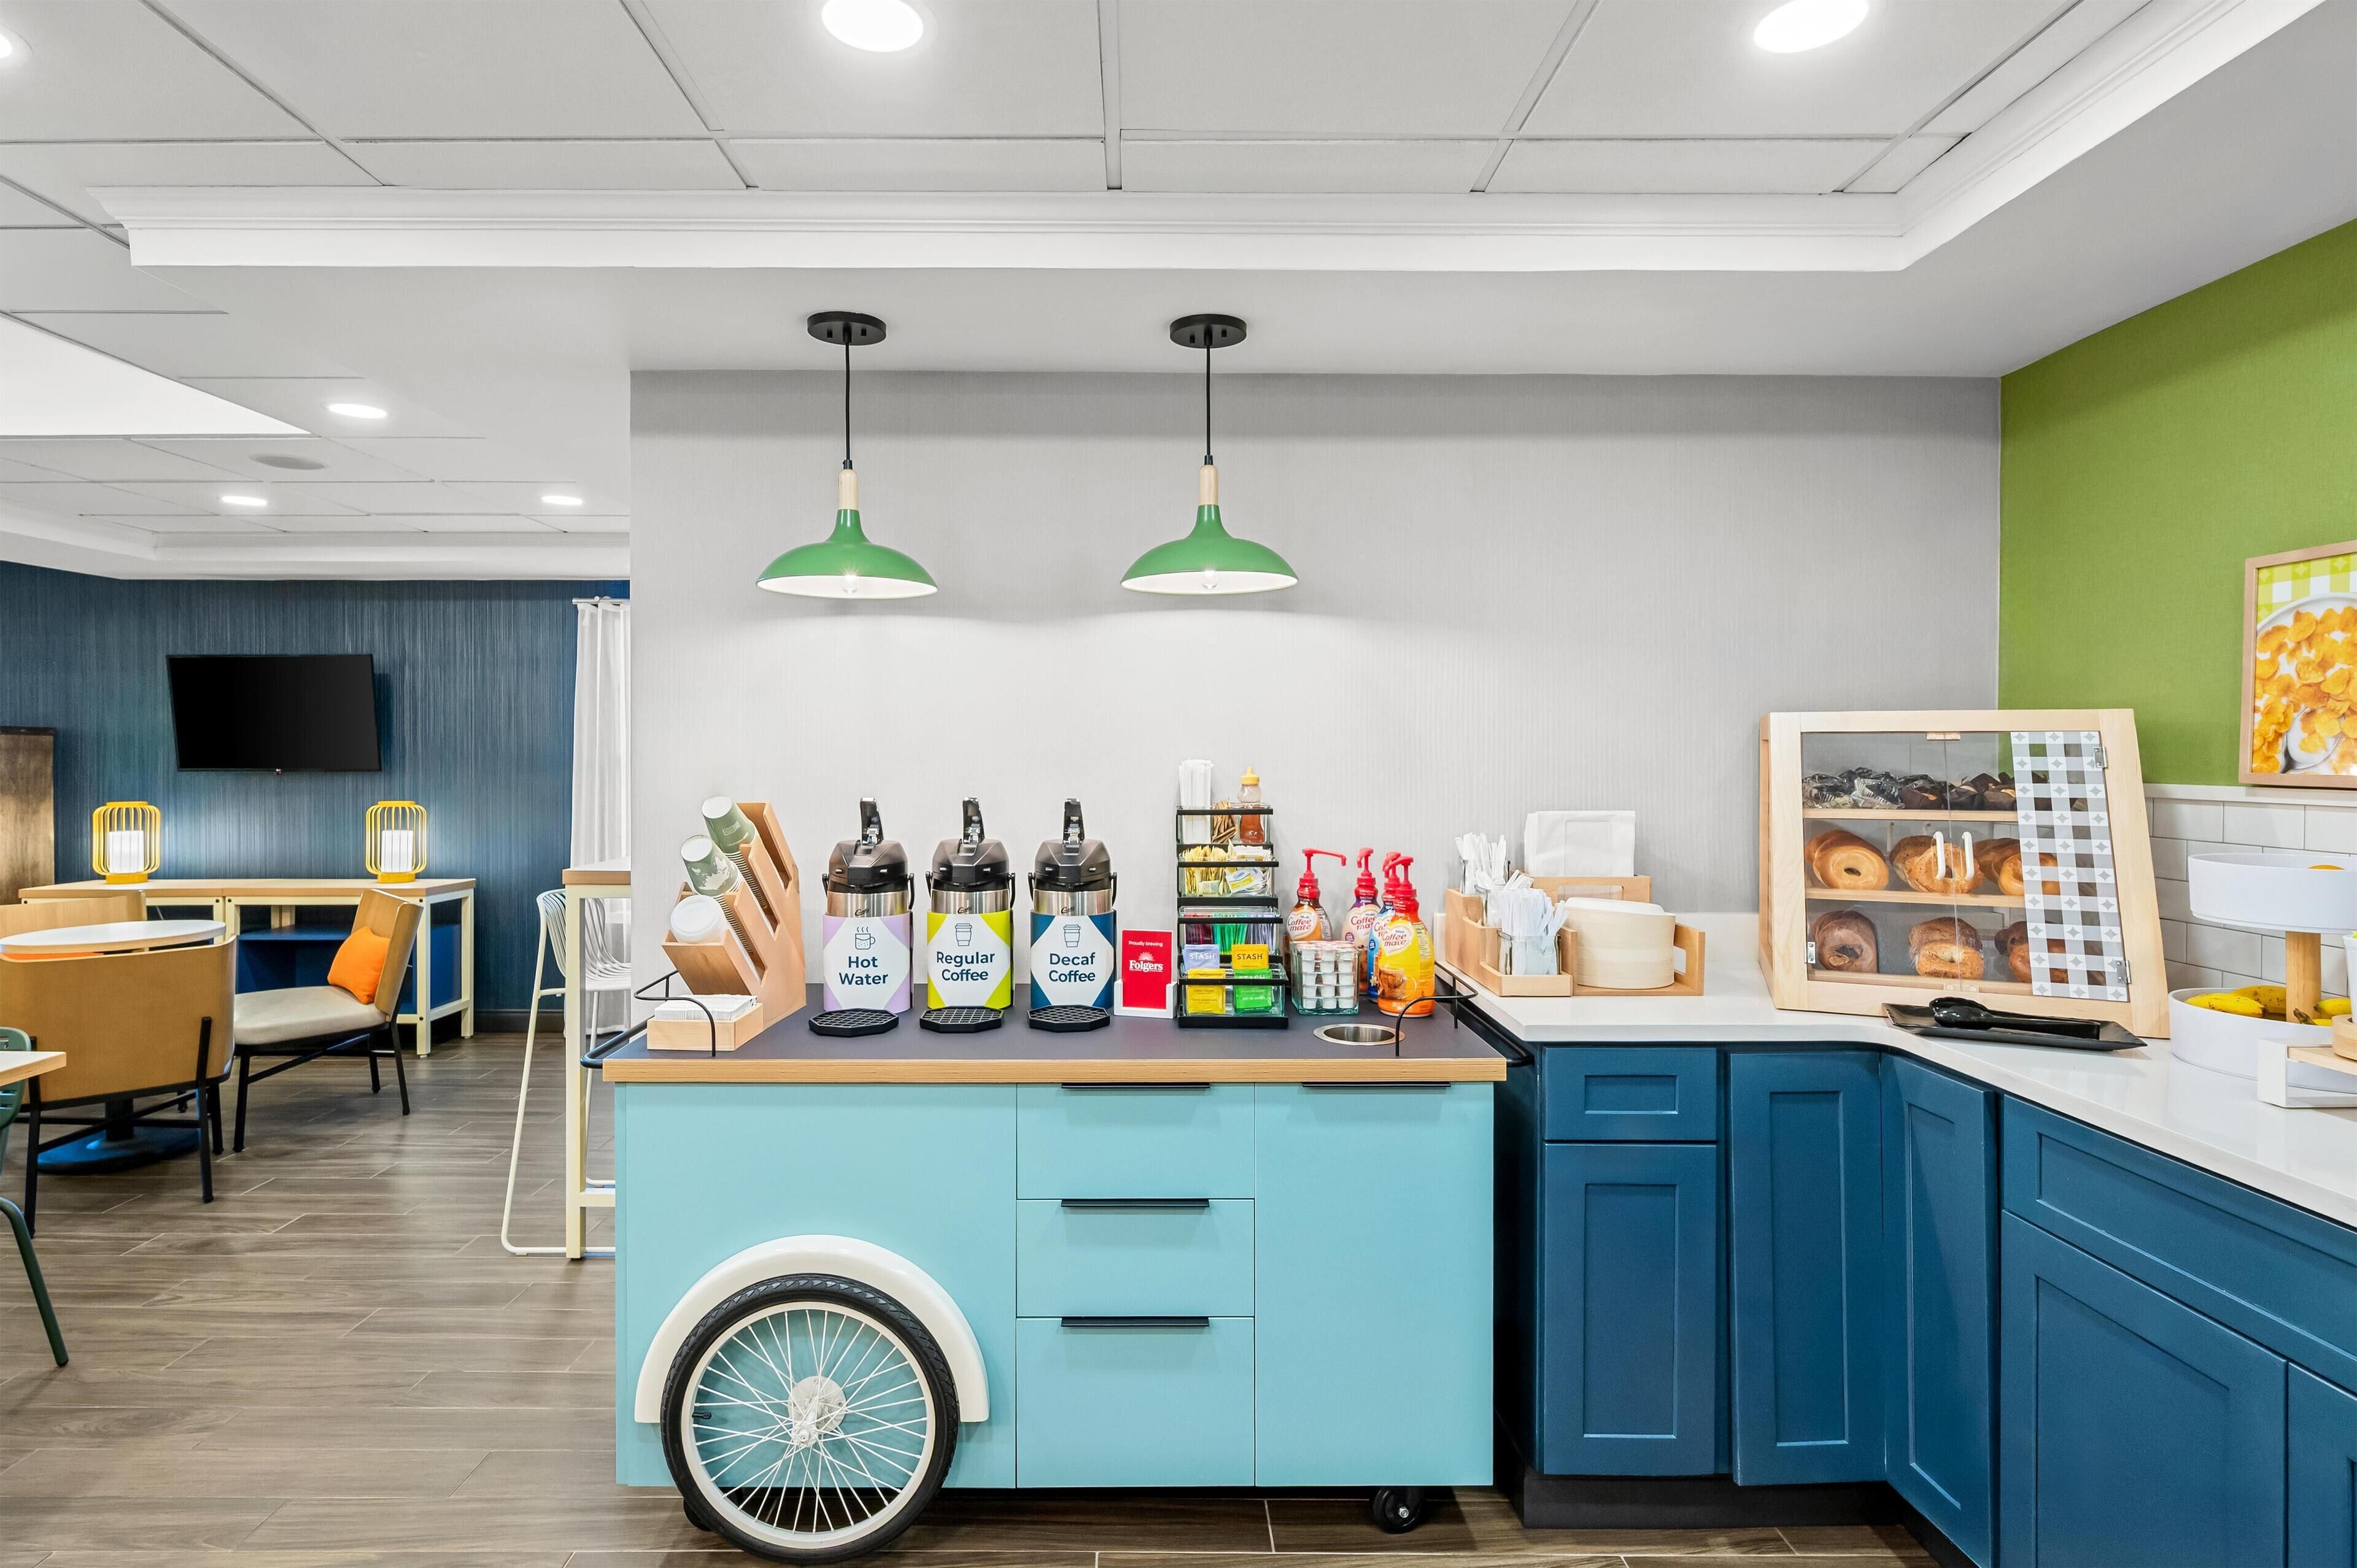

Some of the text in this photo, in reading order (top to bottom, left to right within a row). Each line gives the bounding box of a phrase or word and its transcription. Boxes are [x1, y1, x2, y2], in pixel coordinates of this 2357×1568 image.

[1288, 917, 1312, 926] Coffee
[1382, 931, 1406, 940] Coffee
[848, 956, 878, 968] Hot
[937, 951, 995, 967] Regular
[1050, 952, 1096, 965] Decaf
[1129, 960, 1163, 972] Folgers
[838, 972, 888, 985] Water
[942, 969, 988, 981] Coffee
[1049, 970, 1096, 983] Coffee
